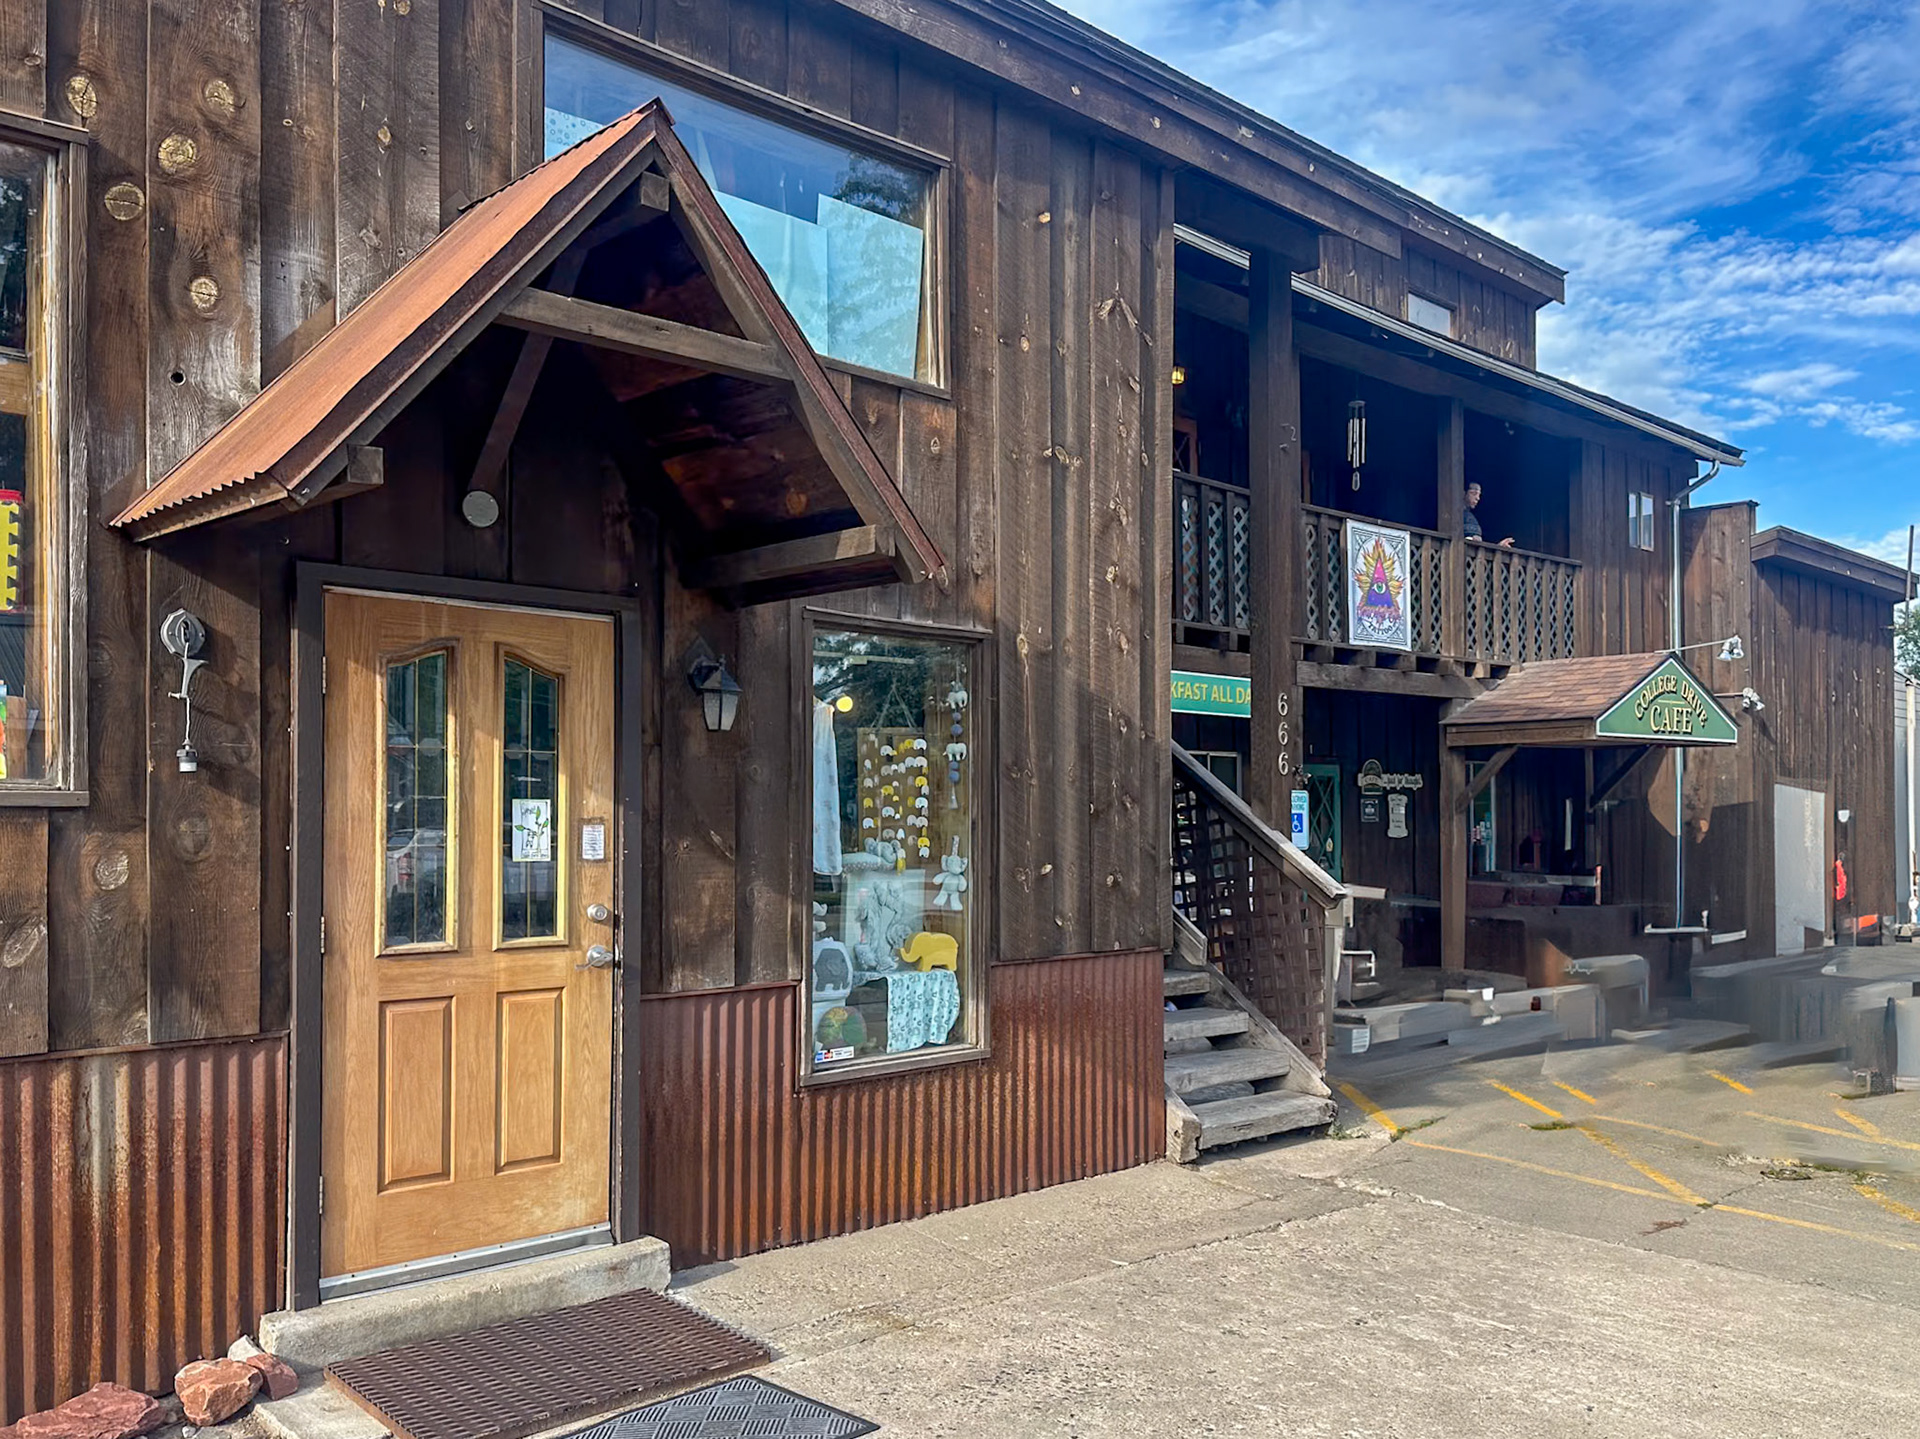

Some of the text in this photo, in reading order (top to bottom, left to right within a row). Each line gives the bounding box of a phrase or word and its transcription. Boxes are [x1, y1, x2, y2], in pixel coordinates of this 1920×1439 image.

[1368, 621, 1393, 635] TATTOO
[1211, 685, 1234, 703] ALL
[1634, 675, 1709, 727] COLLEGE DRIVE
[1650, 705, 1693, 733] CAFE
